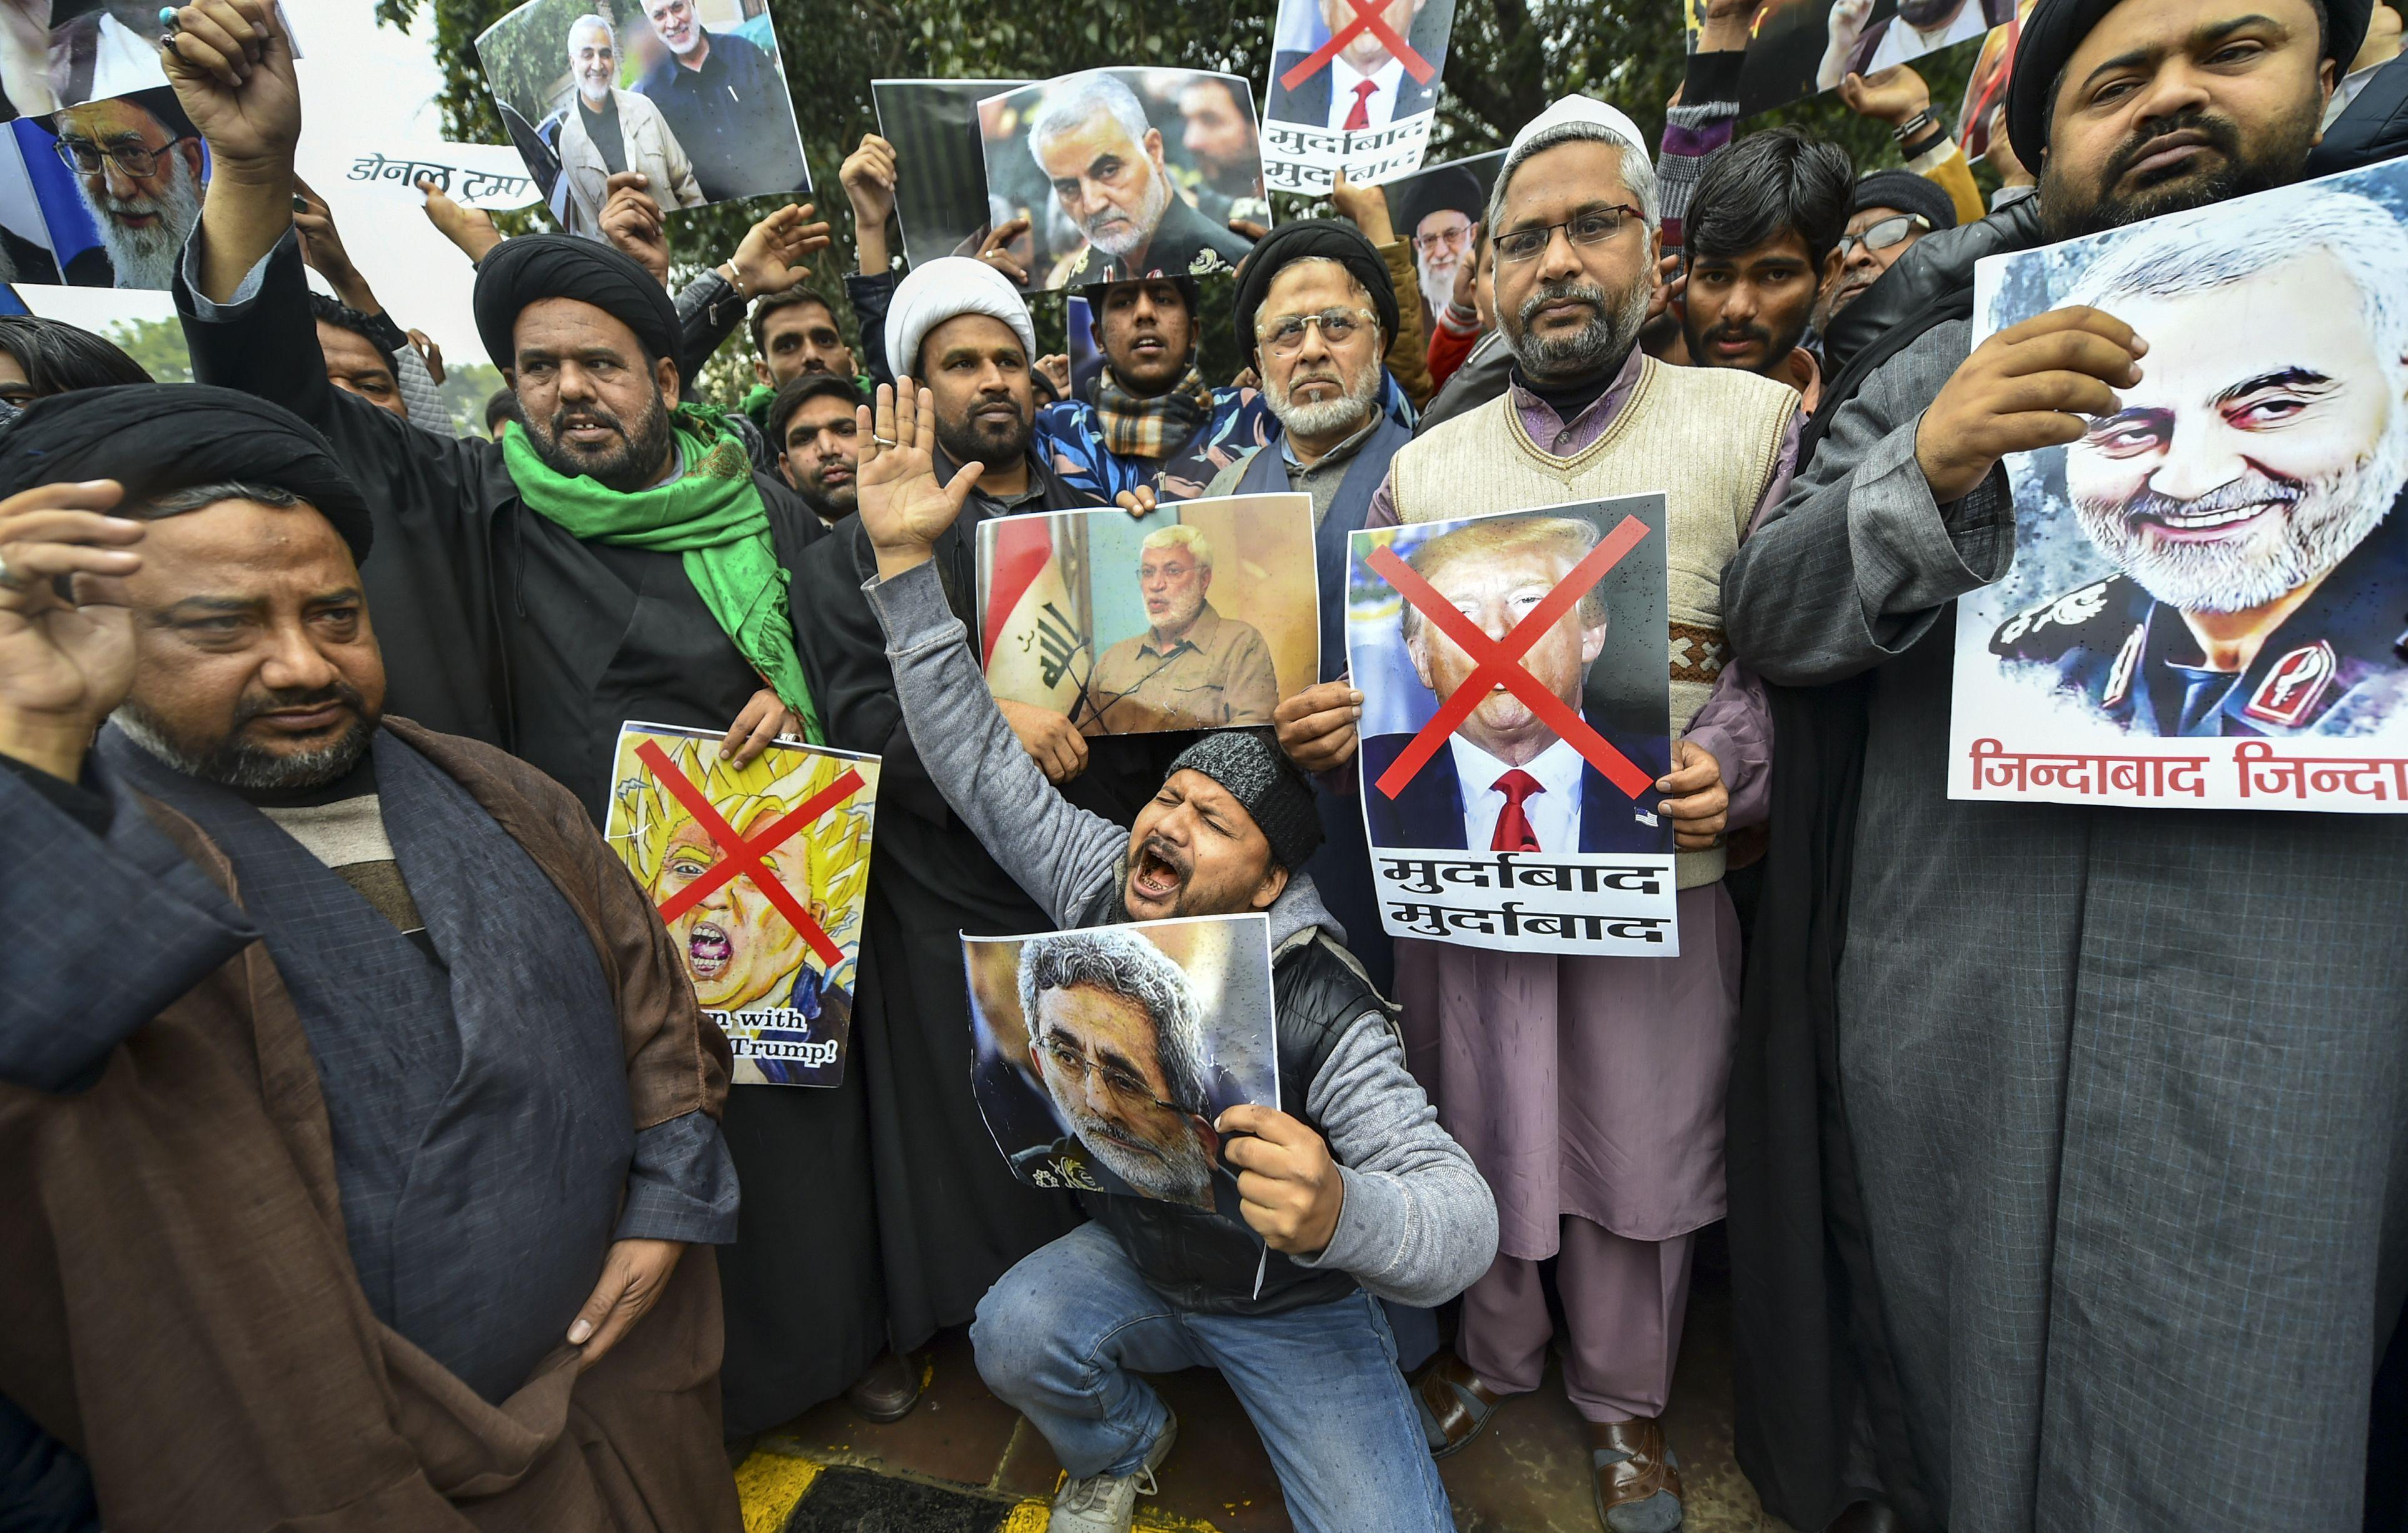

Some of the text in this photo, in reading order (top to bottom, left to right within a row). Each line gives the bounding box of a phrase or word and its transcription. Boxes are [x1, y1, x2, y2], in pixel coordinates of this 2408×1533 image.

[1969, 738, 2210, 797] जिन्दाबाद
[1379, 853, 1669, 894] मुर्दाबाद
[1386, 901, 1672, 943] मुर्दाबाद
[739, 1009, 804, 1029] with
[729, 1038, 834, 1065] Trump!
